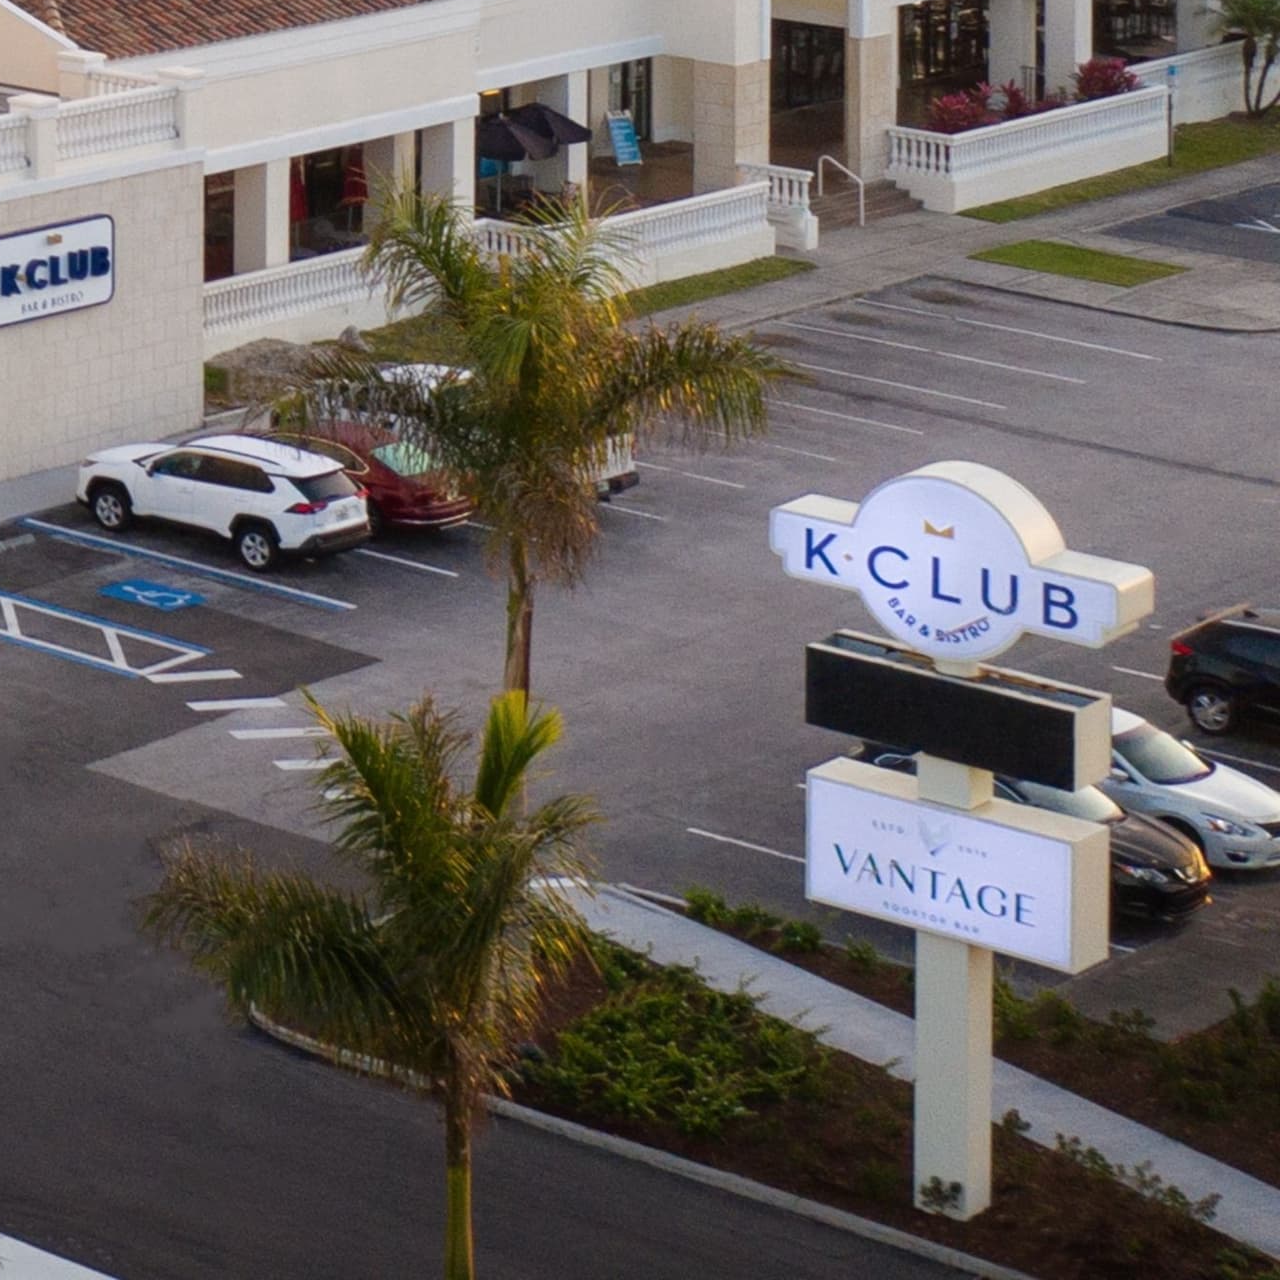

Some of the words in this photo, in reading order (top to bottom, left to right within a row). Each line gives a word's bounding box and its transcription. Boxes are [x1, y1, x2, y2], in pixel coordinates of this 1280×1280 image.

[887, 597, 916, 626] BAR
[918, 623, 930, 637] &
[935, 618, 990, 644] BISTRO
[833, 842, 1036, 928] VANTAGE
